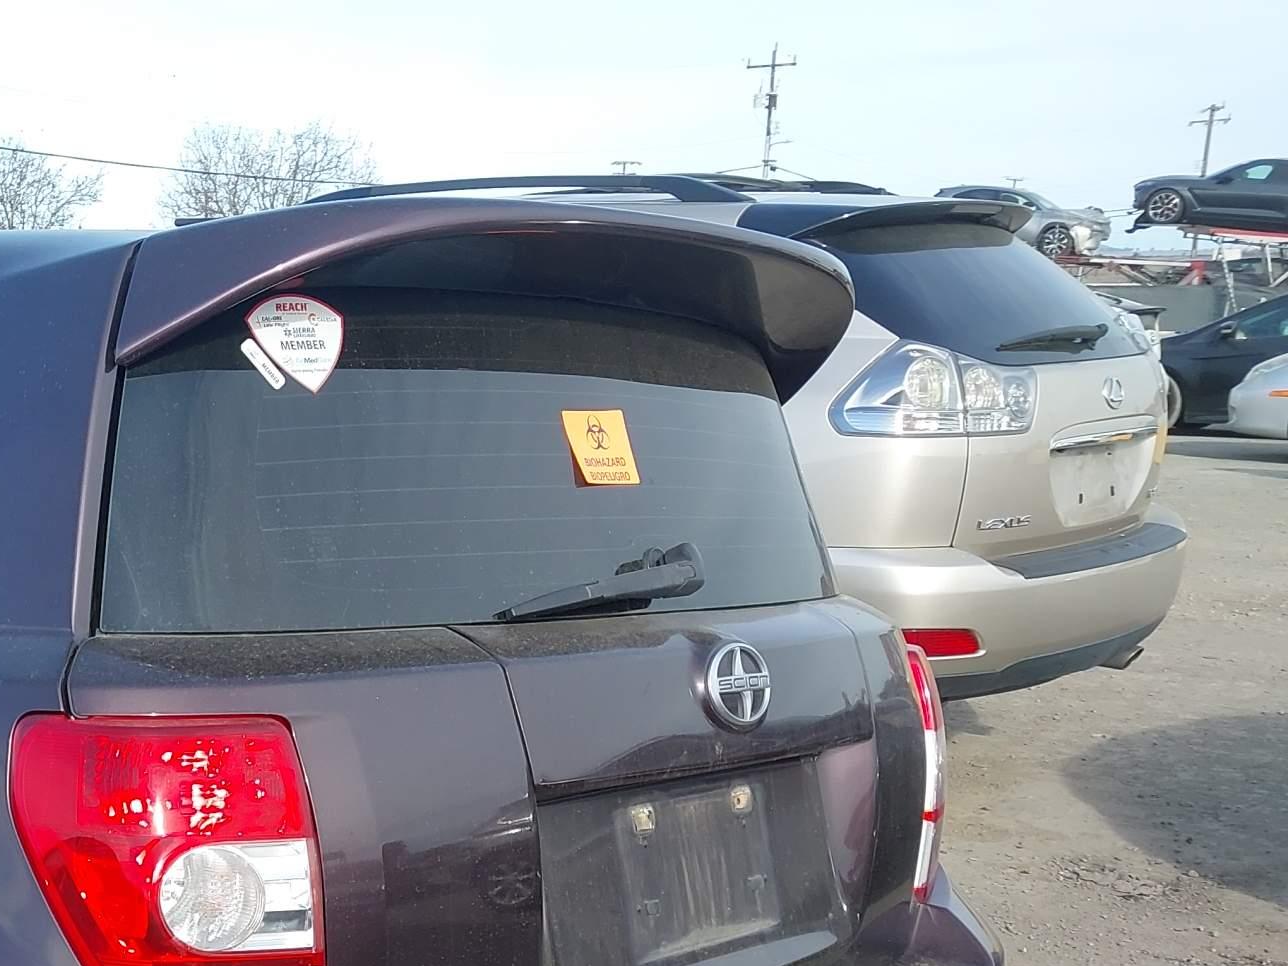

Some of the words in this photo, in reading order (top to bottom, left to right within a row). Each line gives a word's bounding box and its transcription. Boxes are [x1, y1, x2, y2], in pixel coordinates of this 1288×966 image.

[280, 340, 326, 351] MEMBER
[584, 457, 626, 467] BIOHAZARD
[589, 472, 631, 481] BIOPELIGRO
[976, 514, 1033, 531] LEXUS
